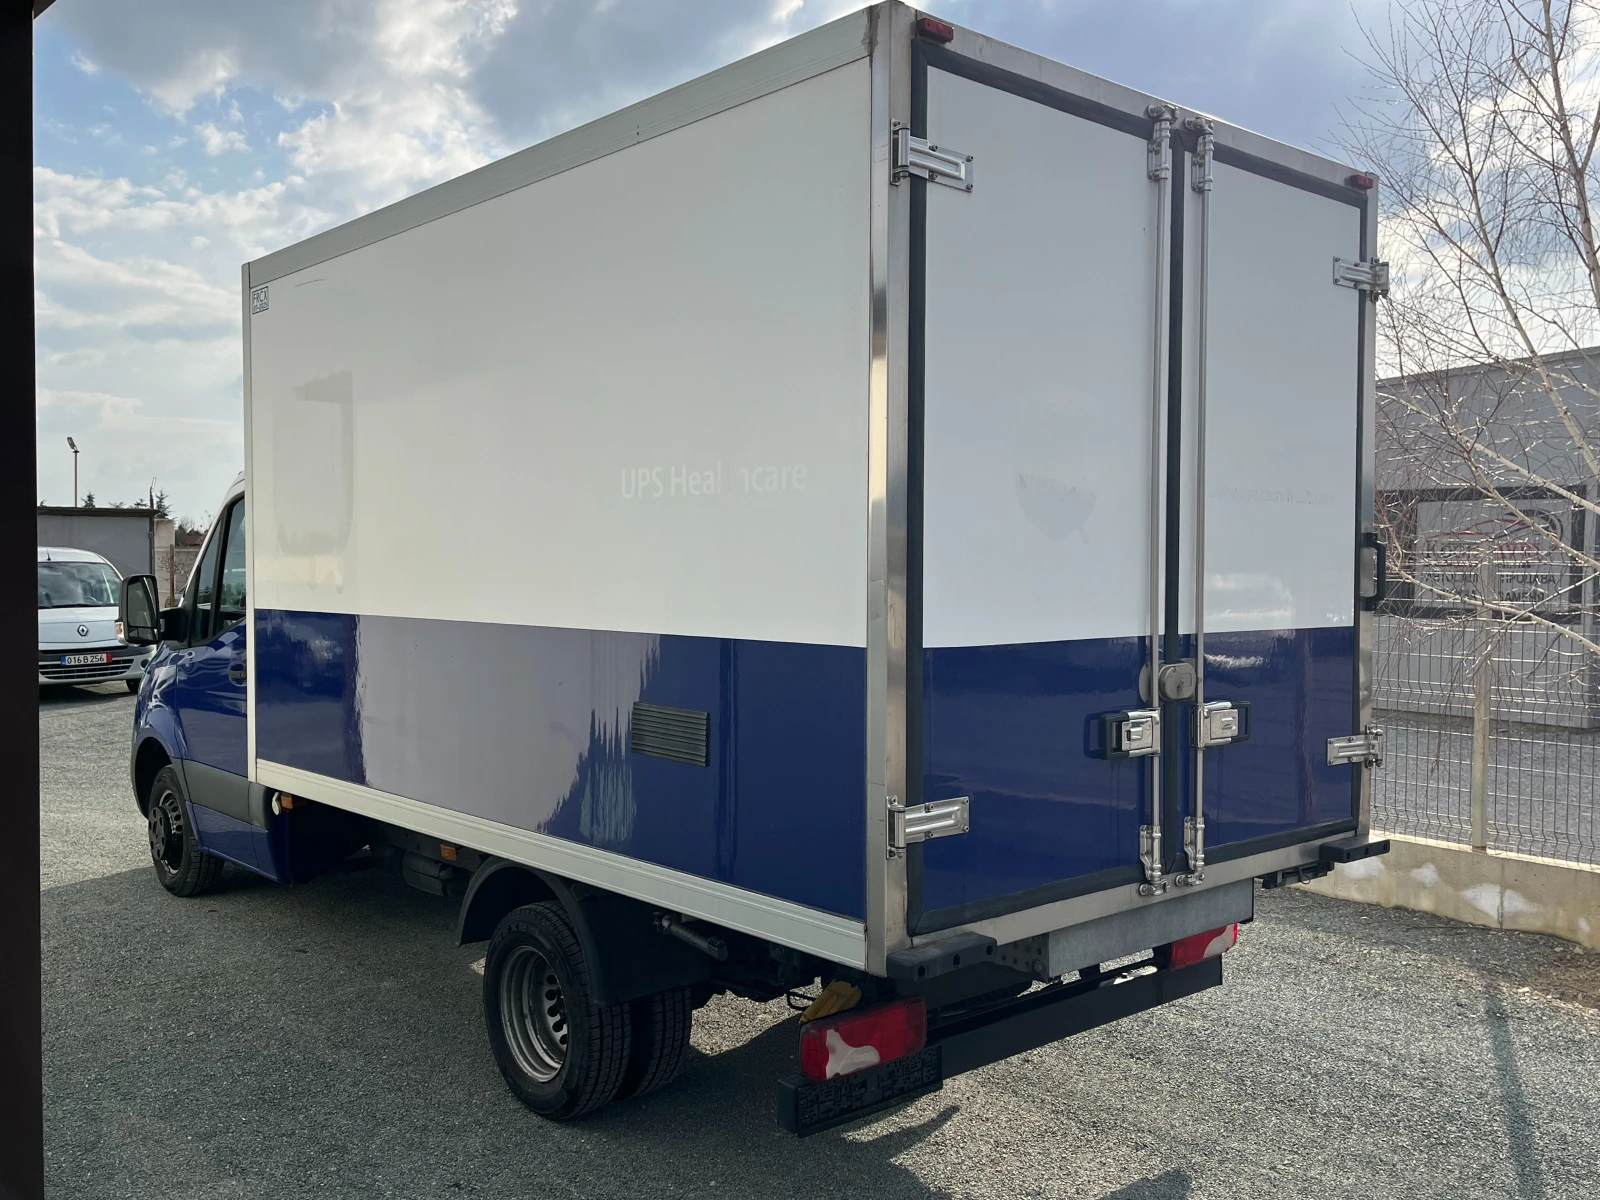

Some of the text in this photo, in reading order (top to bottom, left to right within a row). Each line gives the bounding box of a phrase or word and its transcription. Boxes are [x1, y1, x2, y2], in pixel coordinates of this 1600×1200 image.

[620, 459, 808, 500] UPS Healcare
[67, 656, 82, 664] 016
[90, 655, 104, 663] 256
